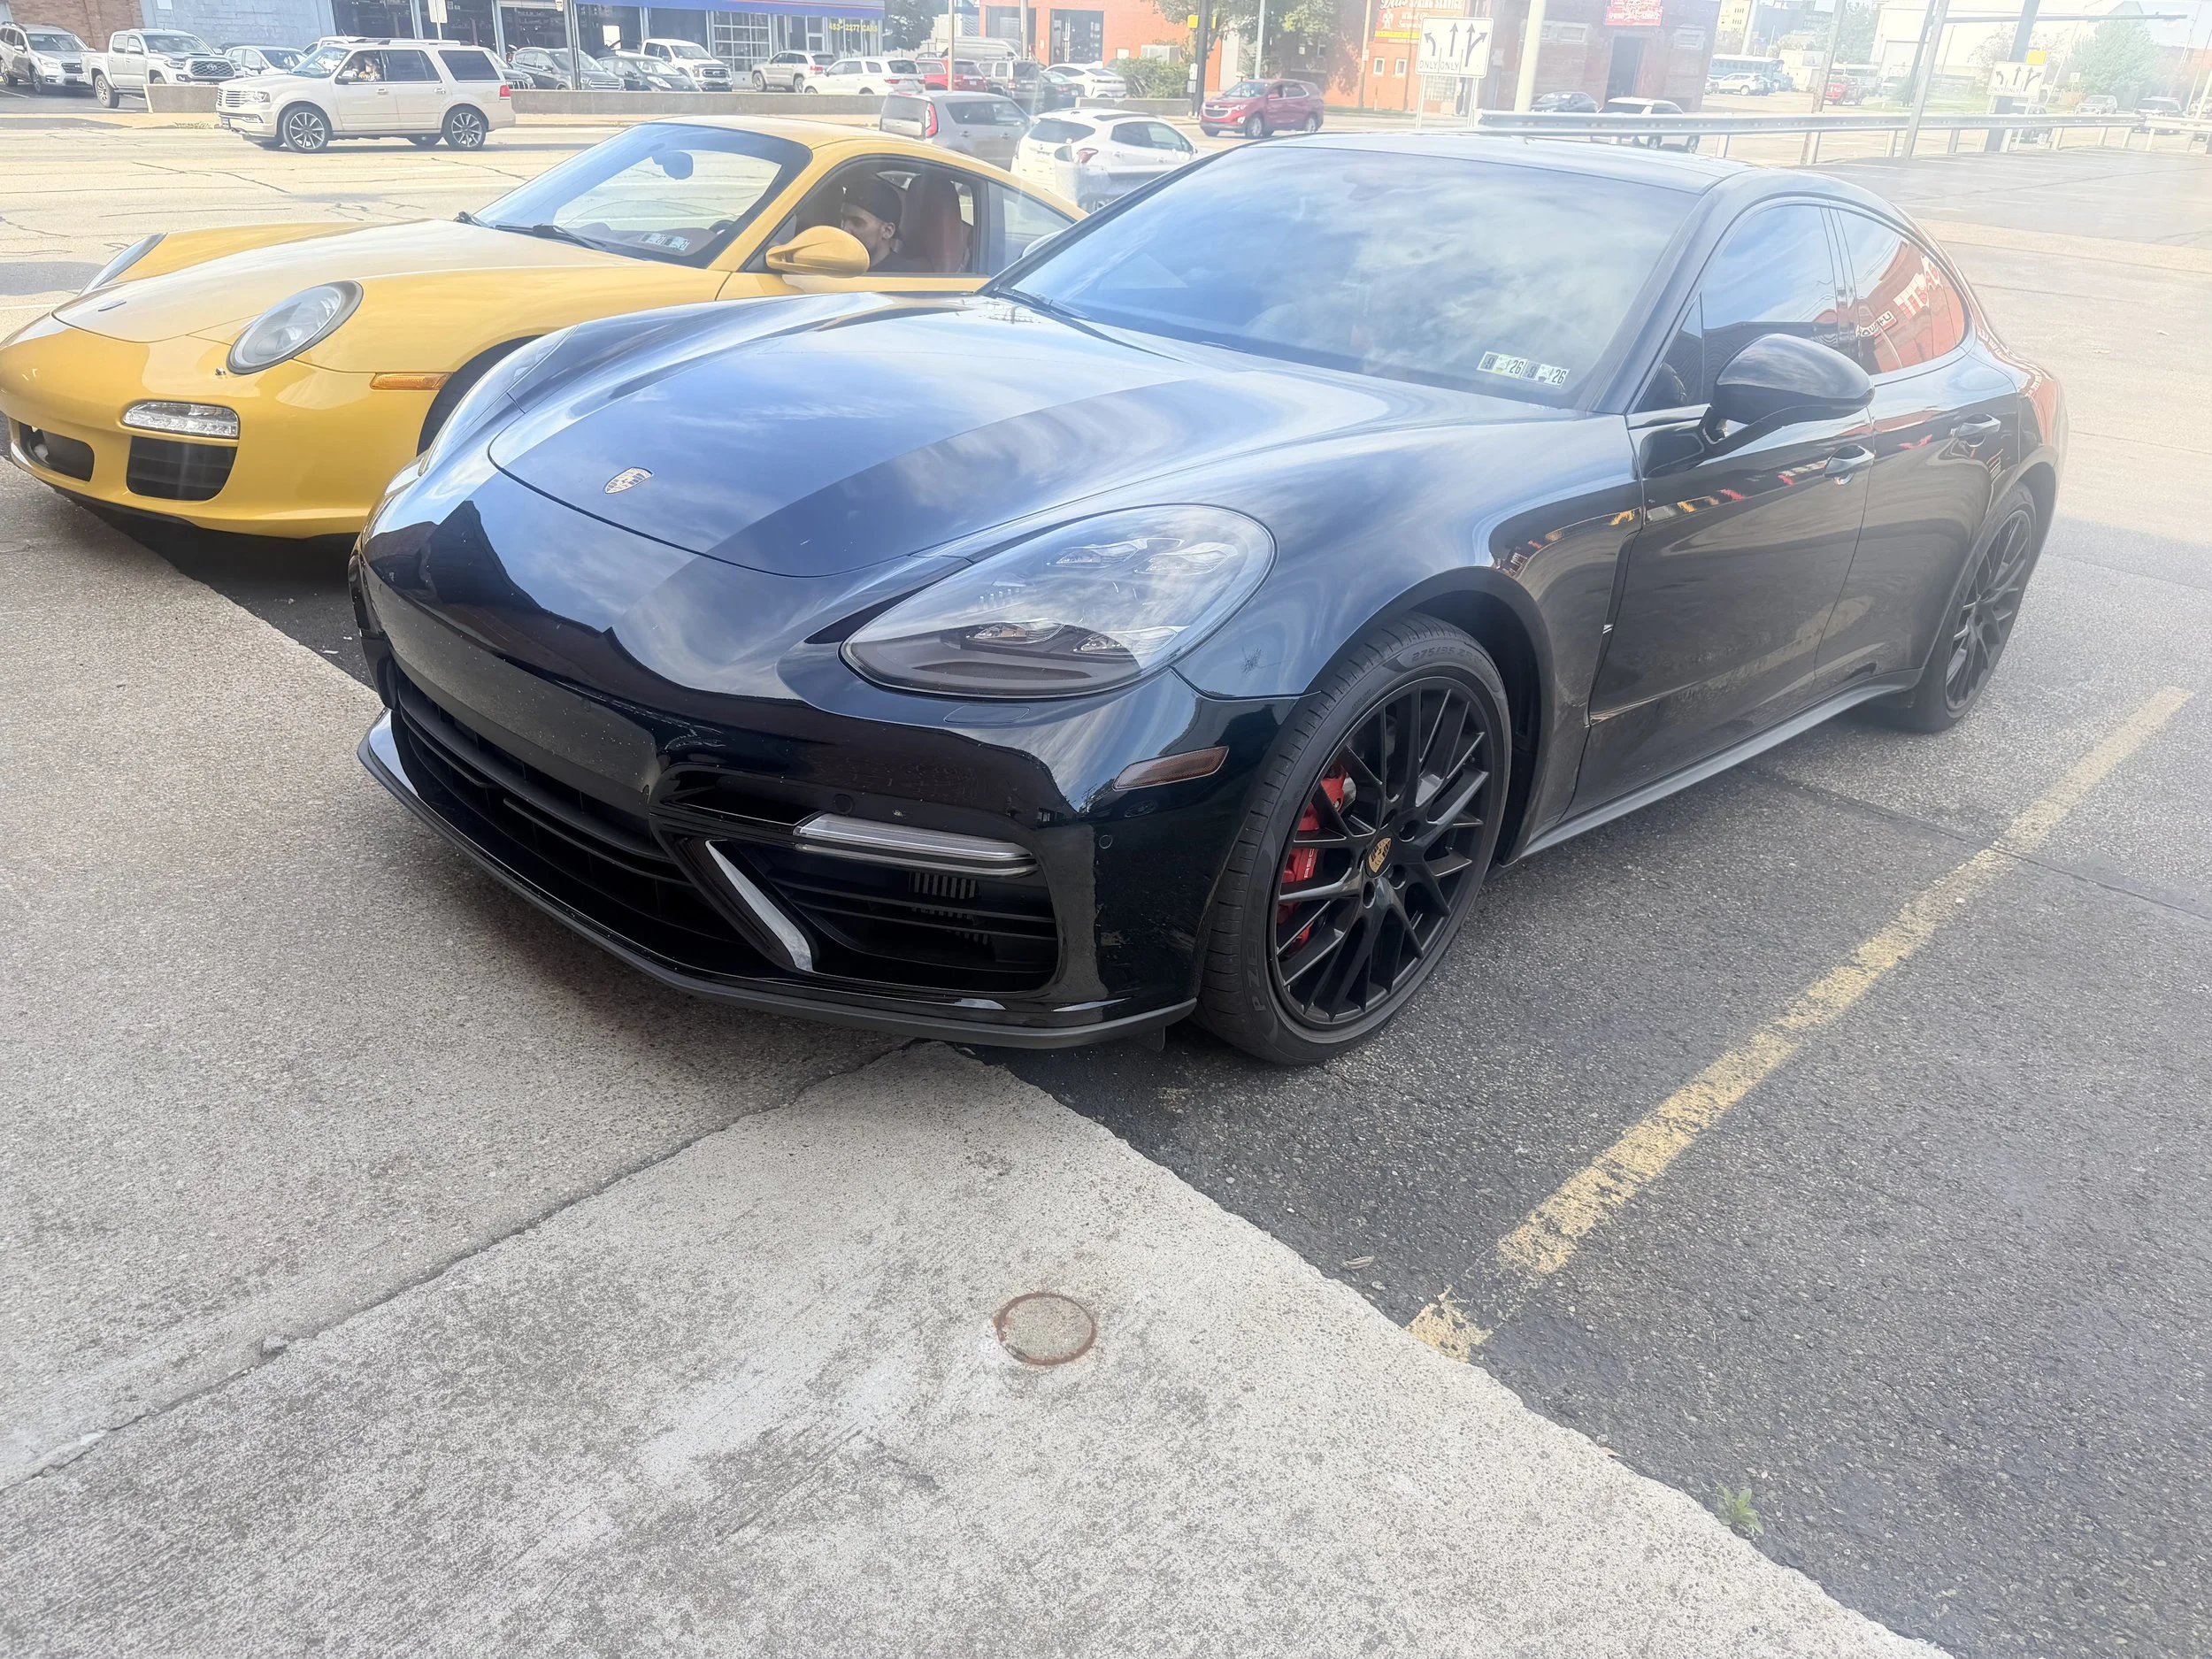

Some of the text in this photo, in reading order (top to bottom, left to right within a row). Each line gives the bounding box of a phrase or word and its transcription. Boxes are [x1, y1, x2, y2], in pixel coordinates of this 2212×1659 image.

[1419, 60, 1459, 71] ONLY ONLY
[1509, 359, 1525, 374] 26
[1552, 369, 1567, 384] 26
